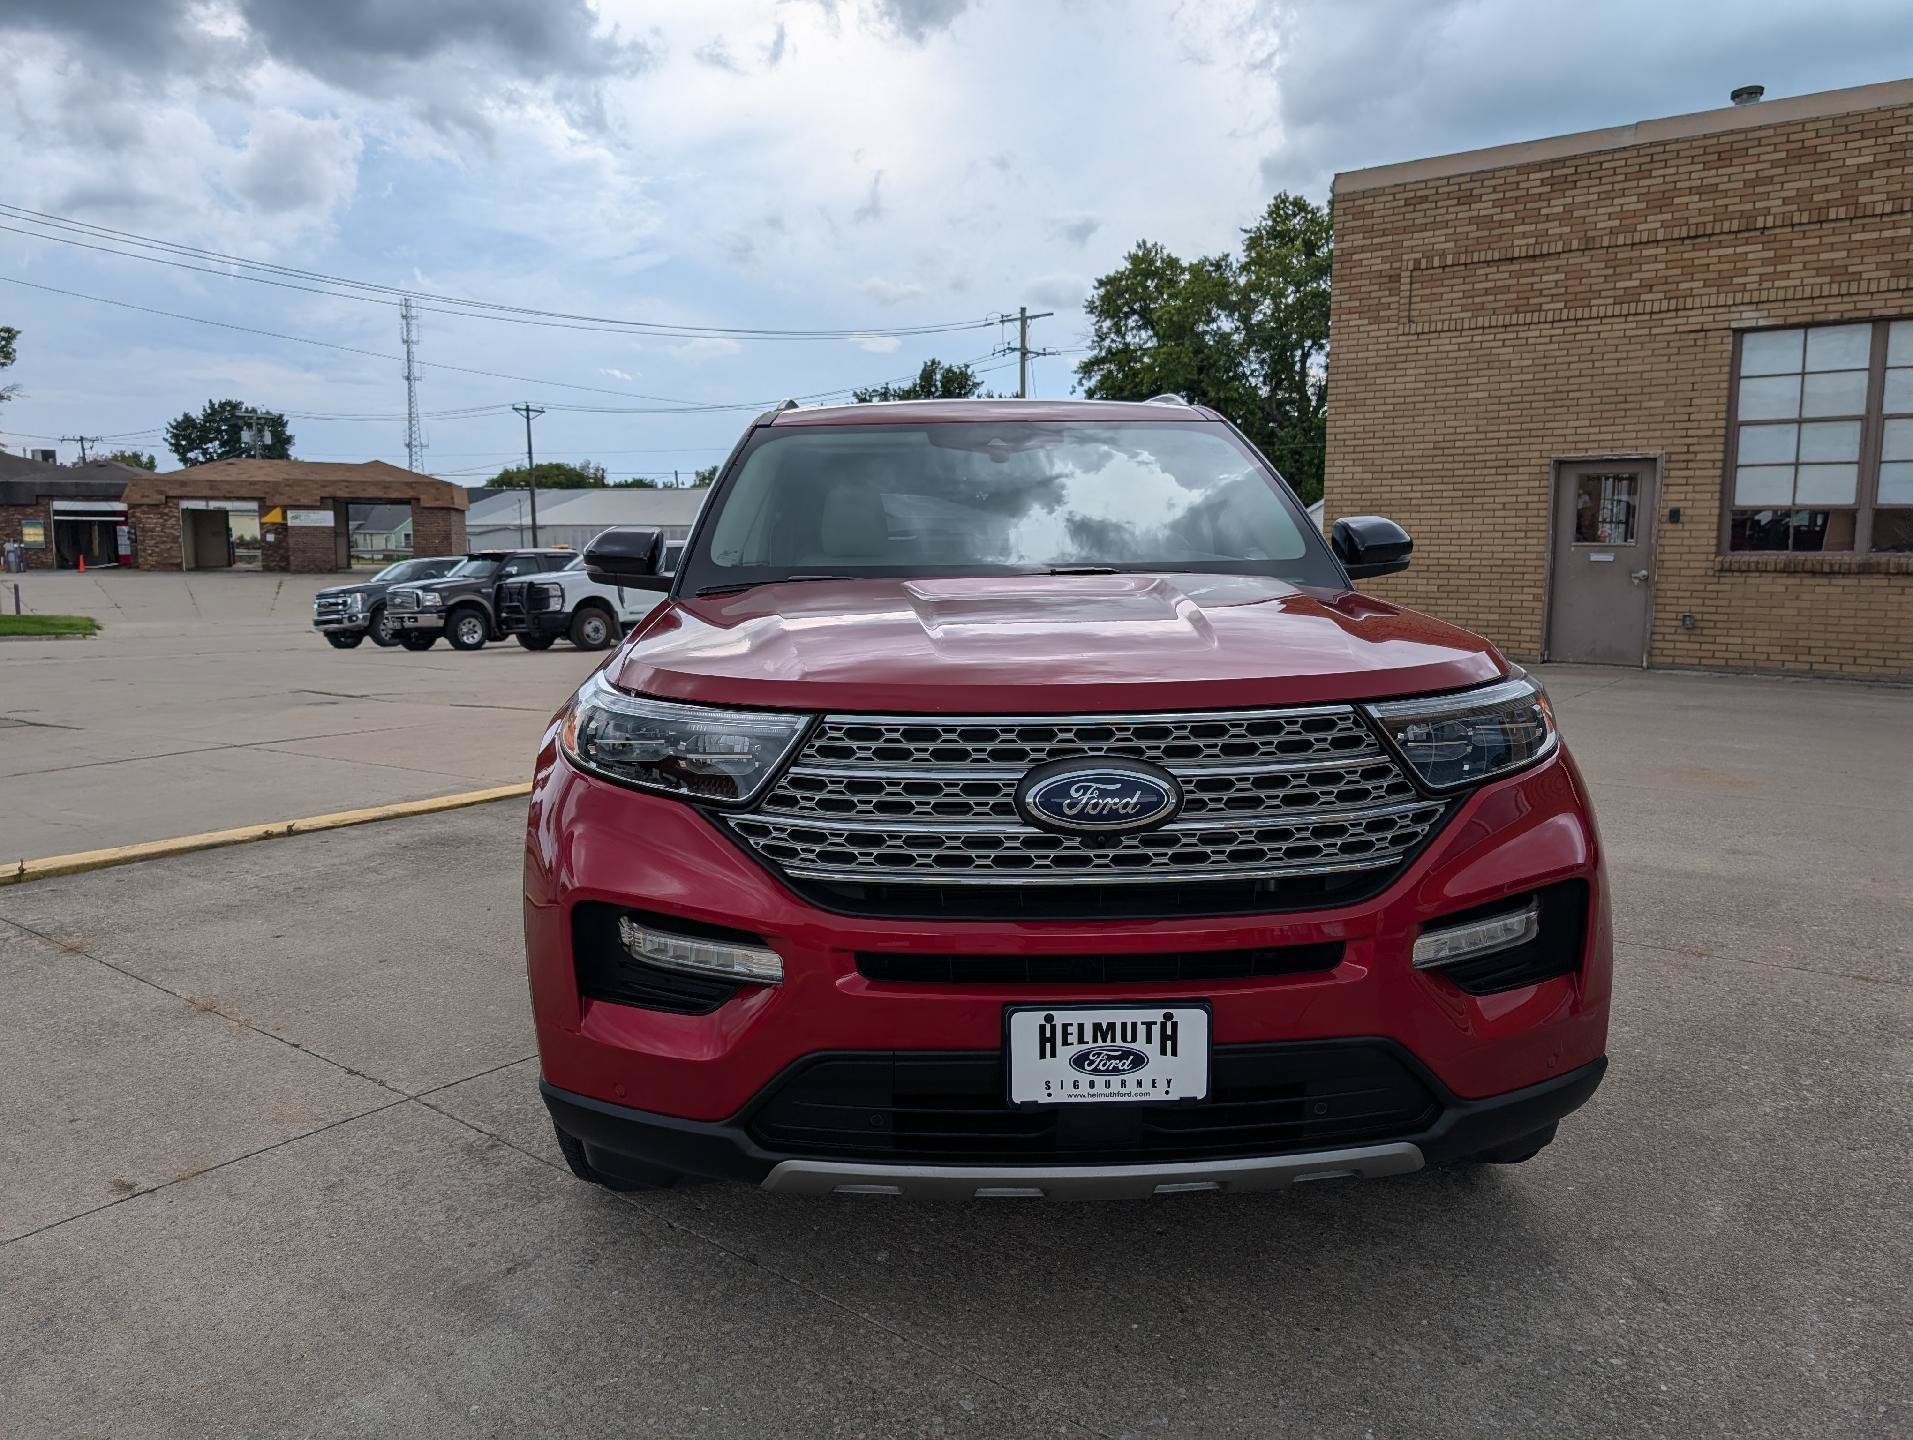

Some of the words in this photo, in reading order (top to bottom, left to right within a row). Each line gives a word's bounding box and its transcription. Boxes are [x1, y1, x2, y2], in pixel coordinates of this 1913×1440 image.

[1062, 783, 1141, 815] Ford
[1038, 1021, 1178, 1060] HELMUTH
[1084, 1050, 1134, 1070] Ford
[1044, 1078, 1172, 1091] SIGOURNEY
[1066, 1090, 1151, 1099] www.helmuthford.com
